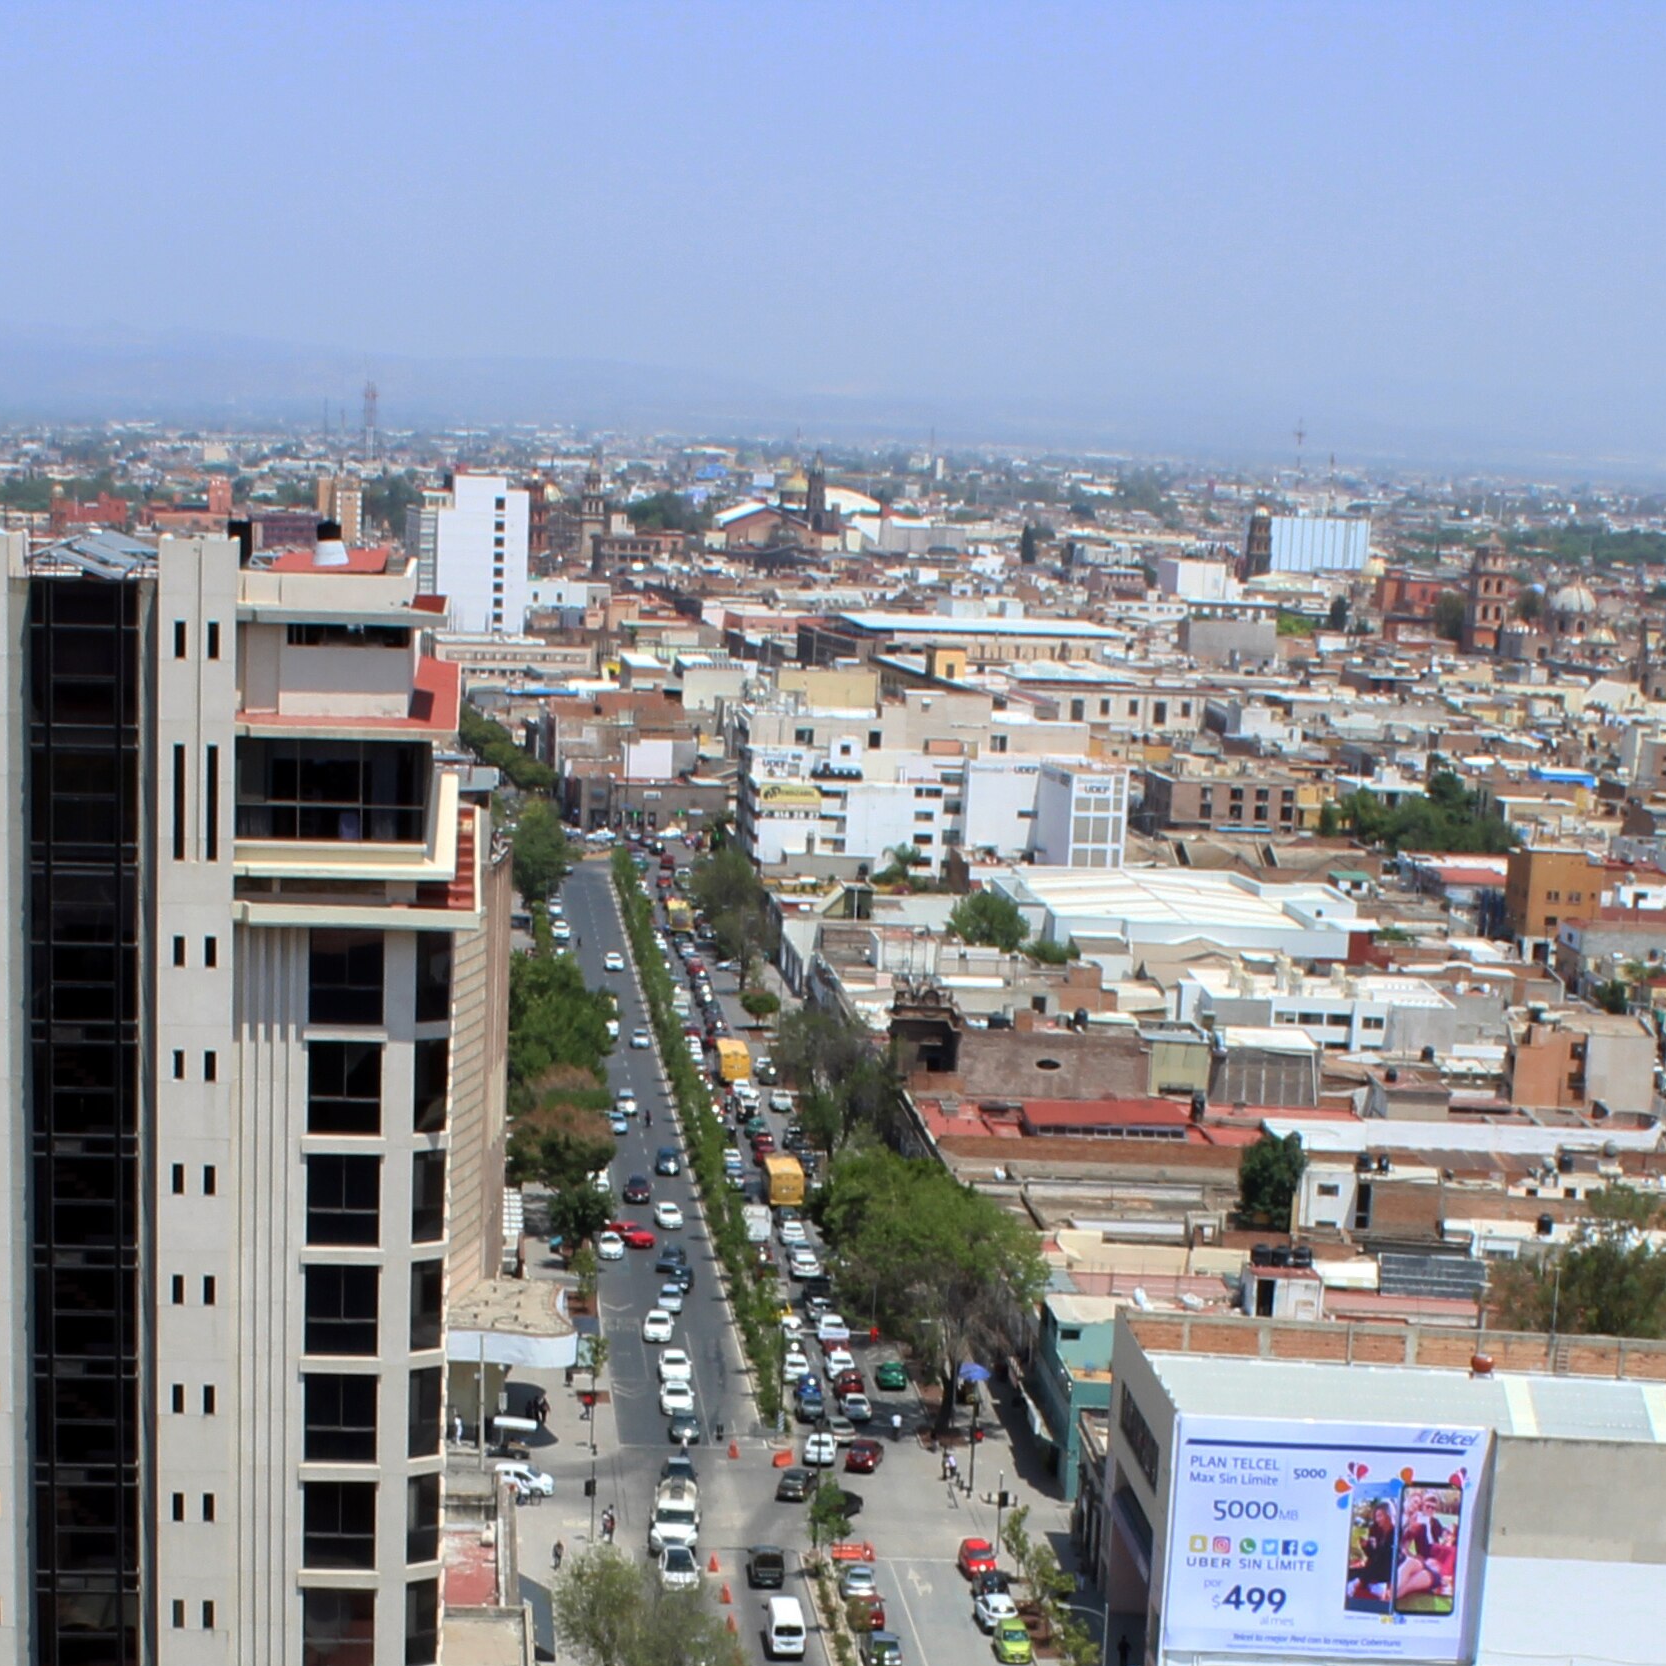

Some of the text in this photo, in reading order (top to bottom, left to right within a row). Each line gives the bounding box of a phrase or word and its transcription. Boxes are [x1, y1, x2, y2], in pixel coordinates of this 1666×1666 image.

[1430, 1430, 1480, 1447] telcel
[1190, 1455, 1280, 1471] PLAN TELCEL
[1189, 1471, 1215, 1483] Max
[1219, 1472, 1238, 1484] Sin
[1293, 1467, 1327, 1480] 5000
[1186, 1556, 1315, 1572] UBER SIN LÍMITE
[1204, 1579, 1223, 1589] por
[1270, 1617, 1294, 1627] mes
